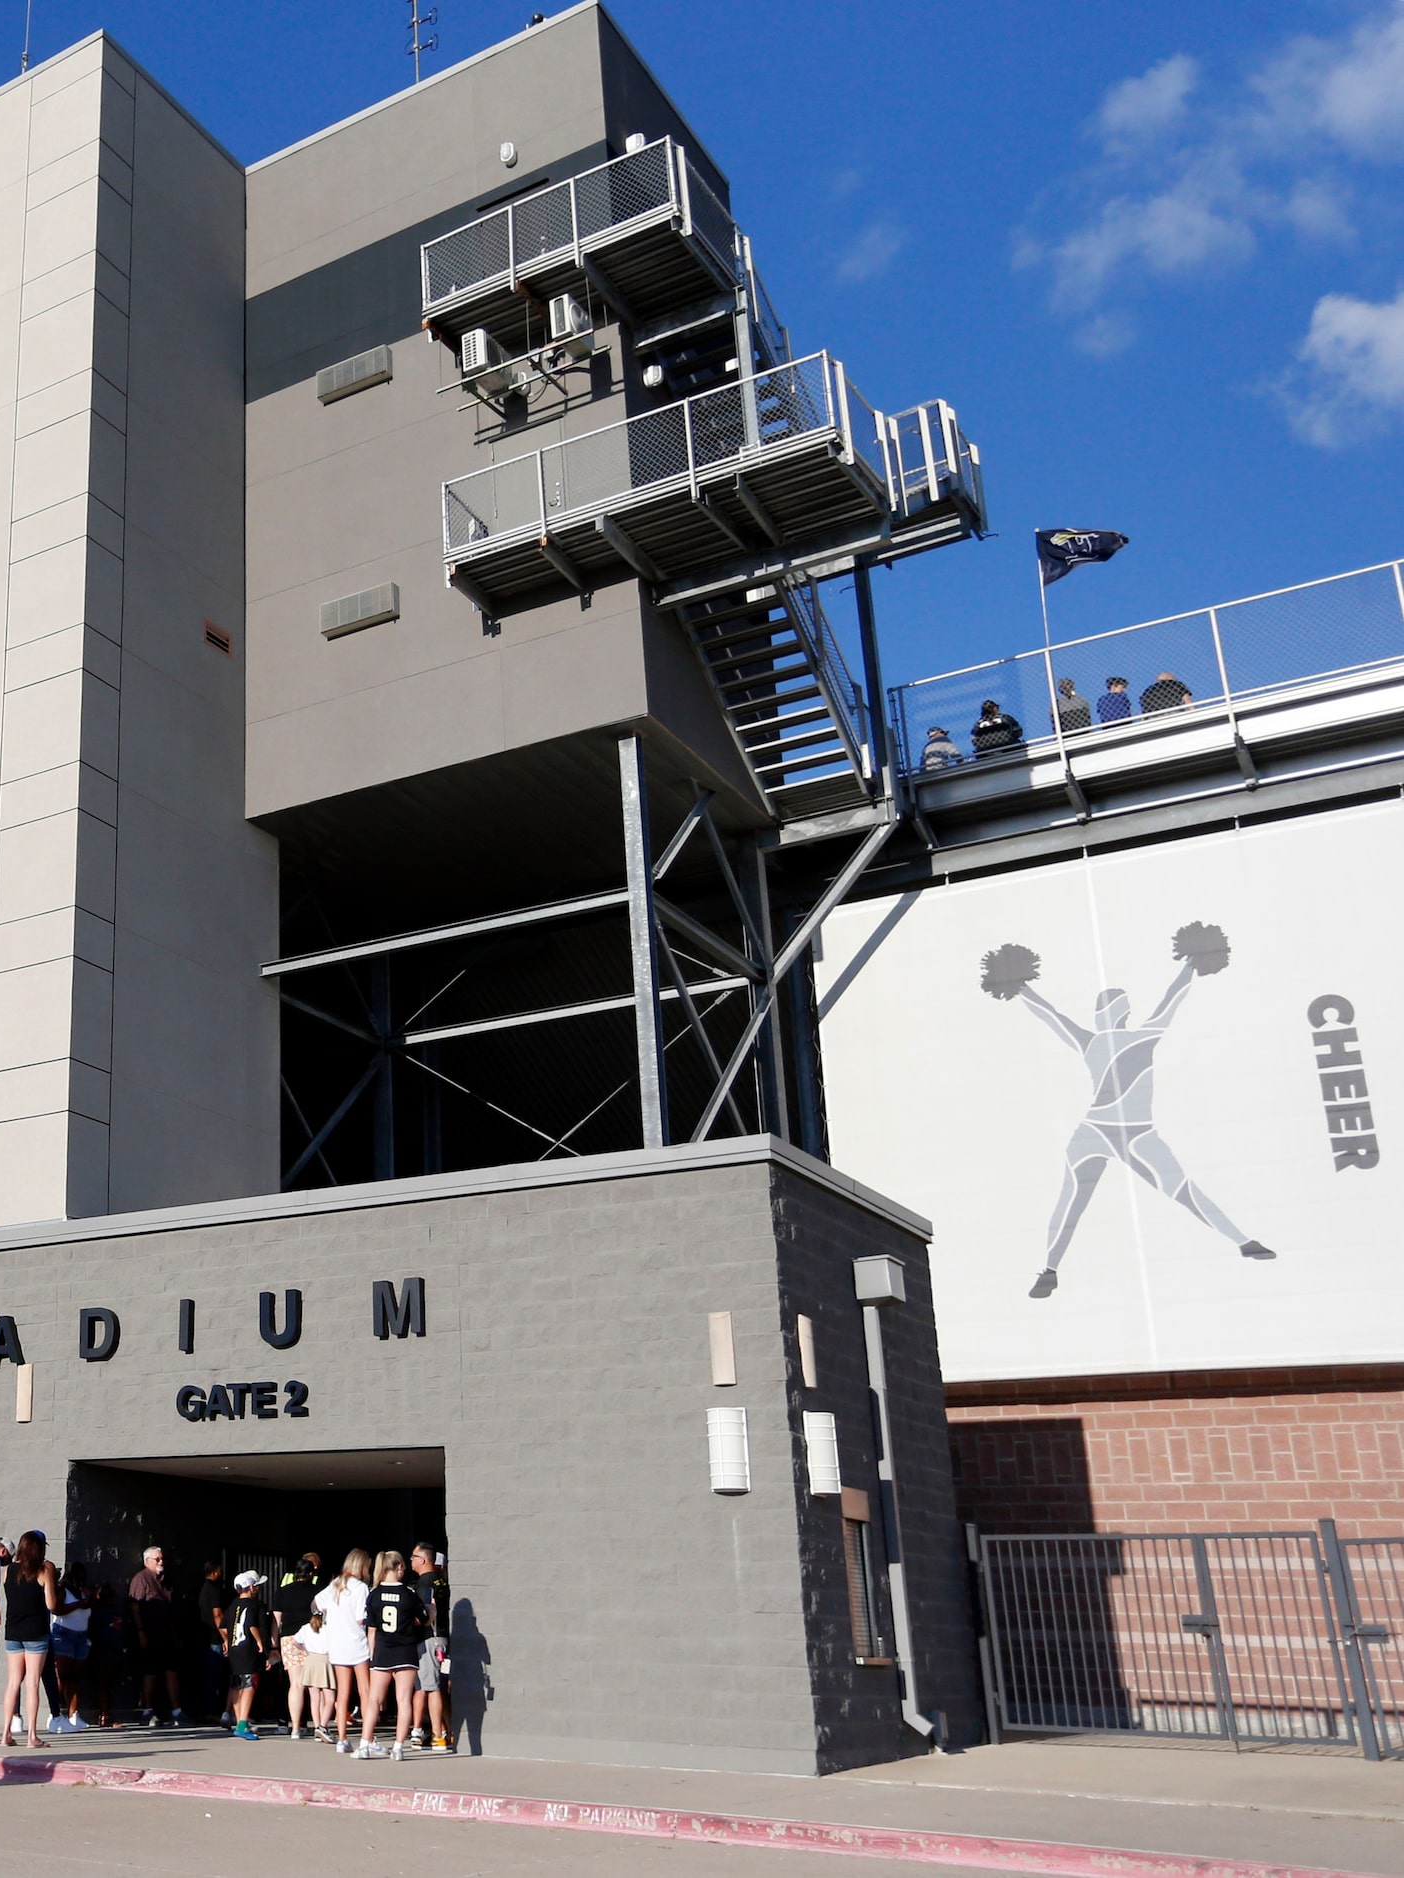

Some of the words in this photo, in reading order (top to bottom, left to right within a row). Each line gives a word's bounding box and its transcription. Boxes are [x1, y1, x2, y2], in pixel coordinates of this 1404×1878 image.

[1307, 994, 1381, 1173] CHEER
[176, 1381, 279, 1423] GATE
[282, 1380, 310, 1418] 2
[381, 1605, 398, 1633] 9
[411, 1792, 448, 1813] FIRE
[459, 1795, 505, 1817] LANE
[544, 1803, 569, 1822] NO
